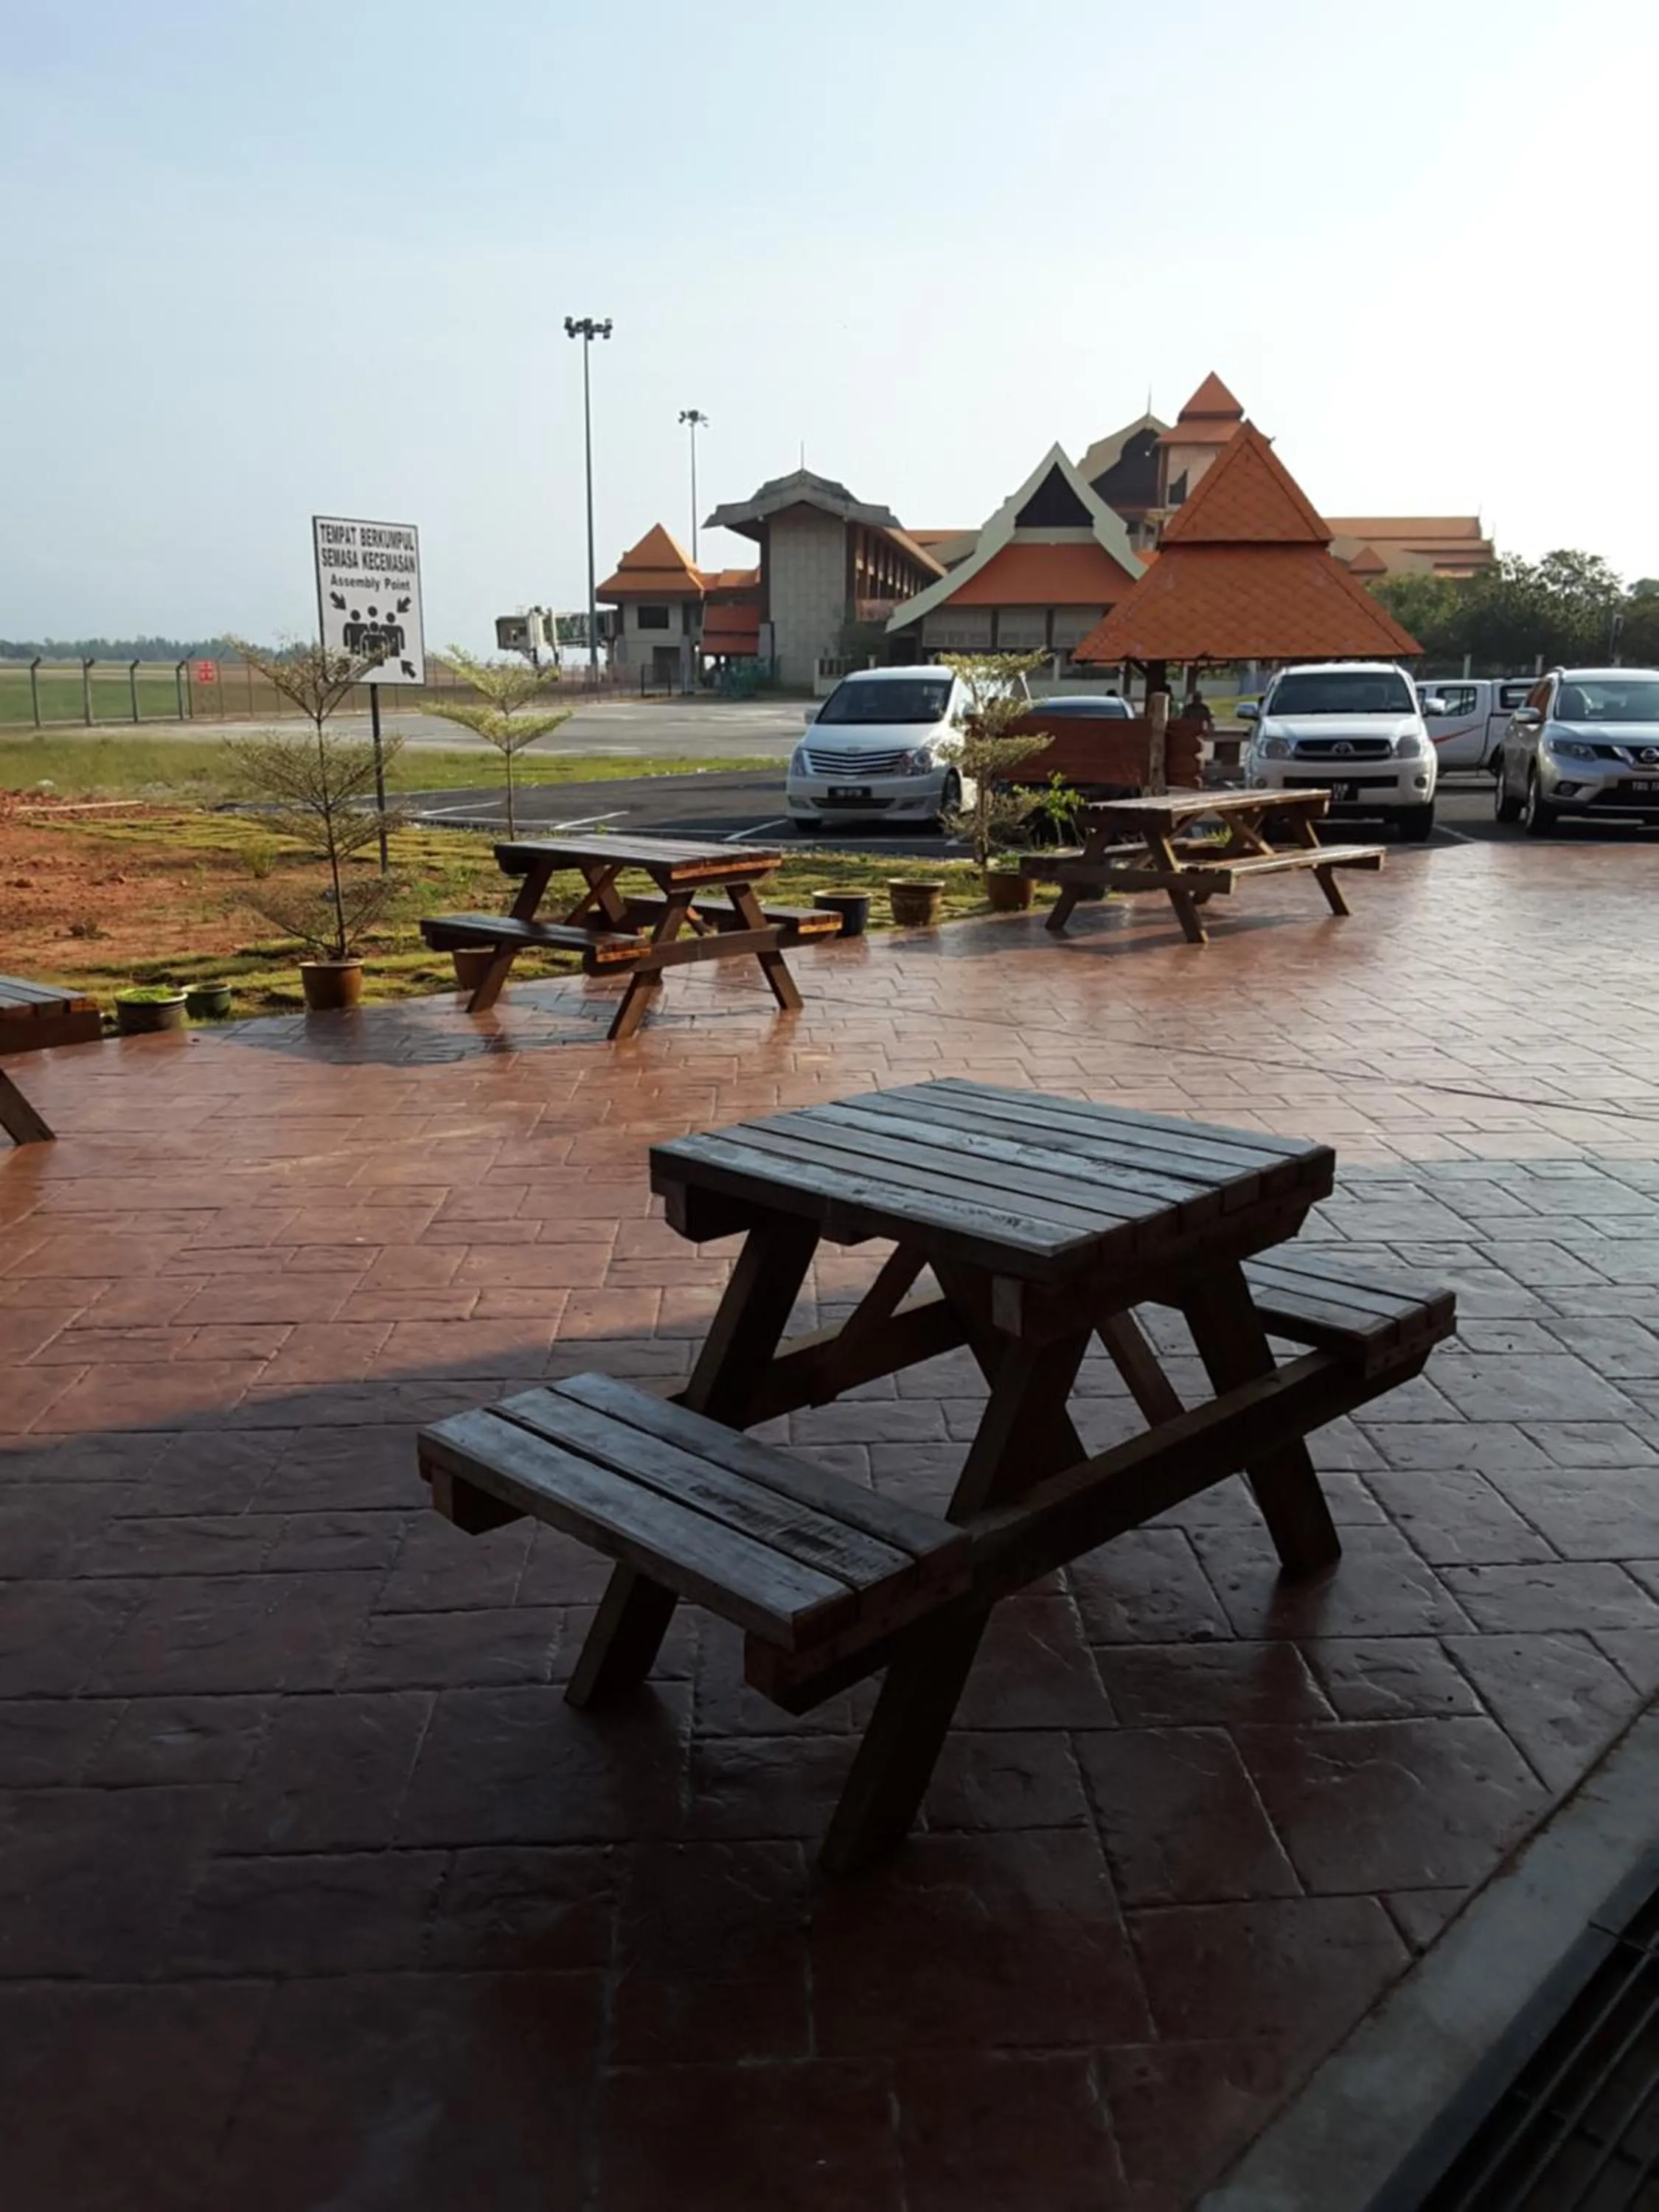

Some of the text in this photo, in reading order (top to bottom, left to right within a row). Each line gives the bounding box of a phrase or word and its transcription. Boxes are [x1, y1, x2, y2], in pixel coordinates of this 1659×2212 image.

[320, 523, 414, 552] TEMPAT BERKUMPUL
[322, 547, 415, 574] SEMASA KECEMASAN
[330, 573, 411, 592] Assembly Point
